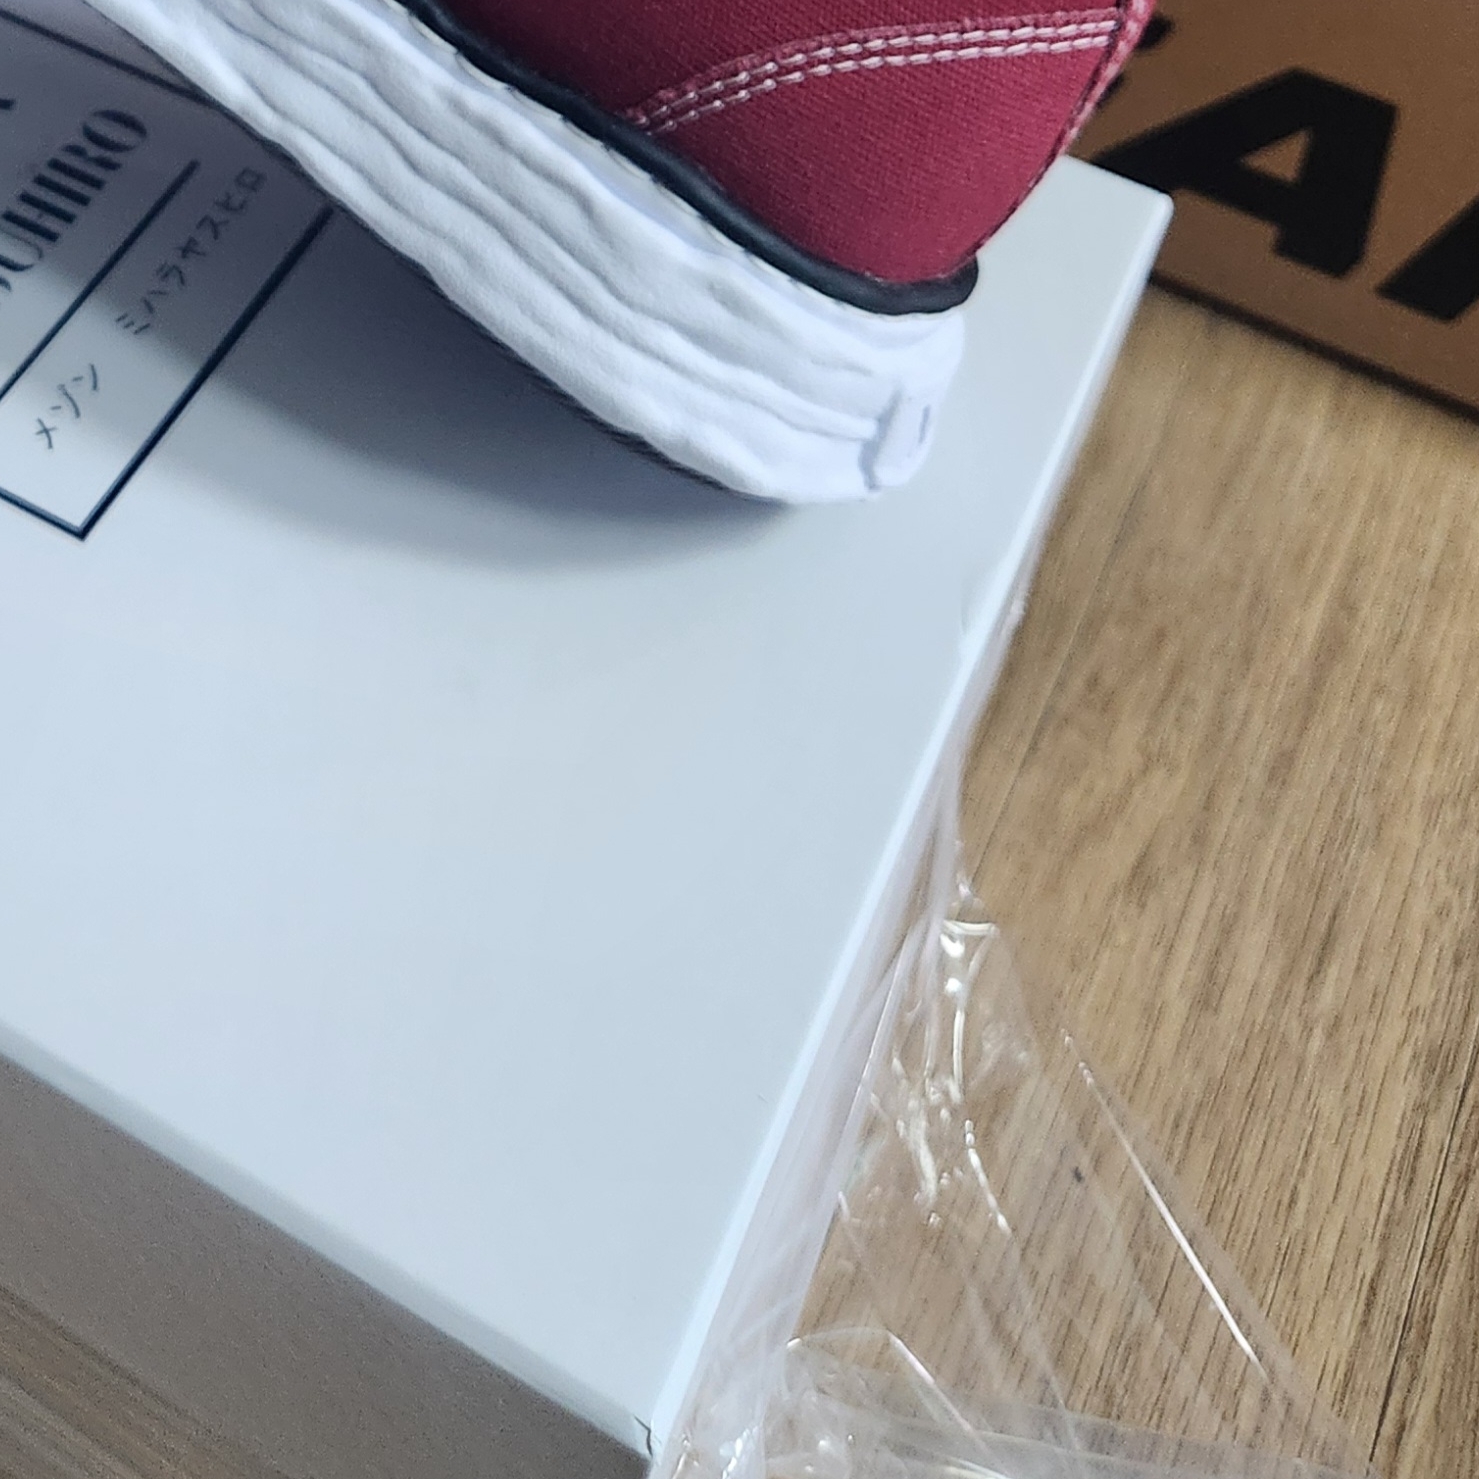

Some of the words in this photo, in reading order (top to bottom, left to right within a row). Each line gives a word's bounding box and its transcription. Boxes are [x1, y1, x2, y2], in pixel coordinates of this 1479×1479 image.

[33, 362, 100, 451] メゾン
[114, 165, 268, 338] ミハラヤスヒロ
